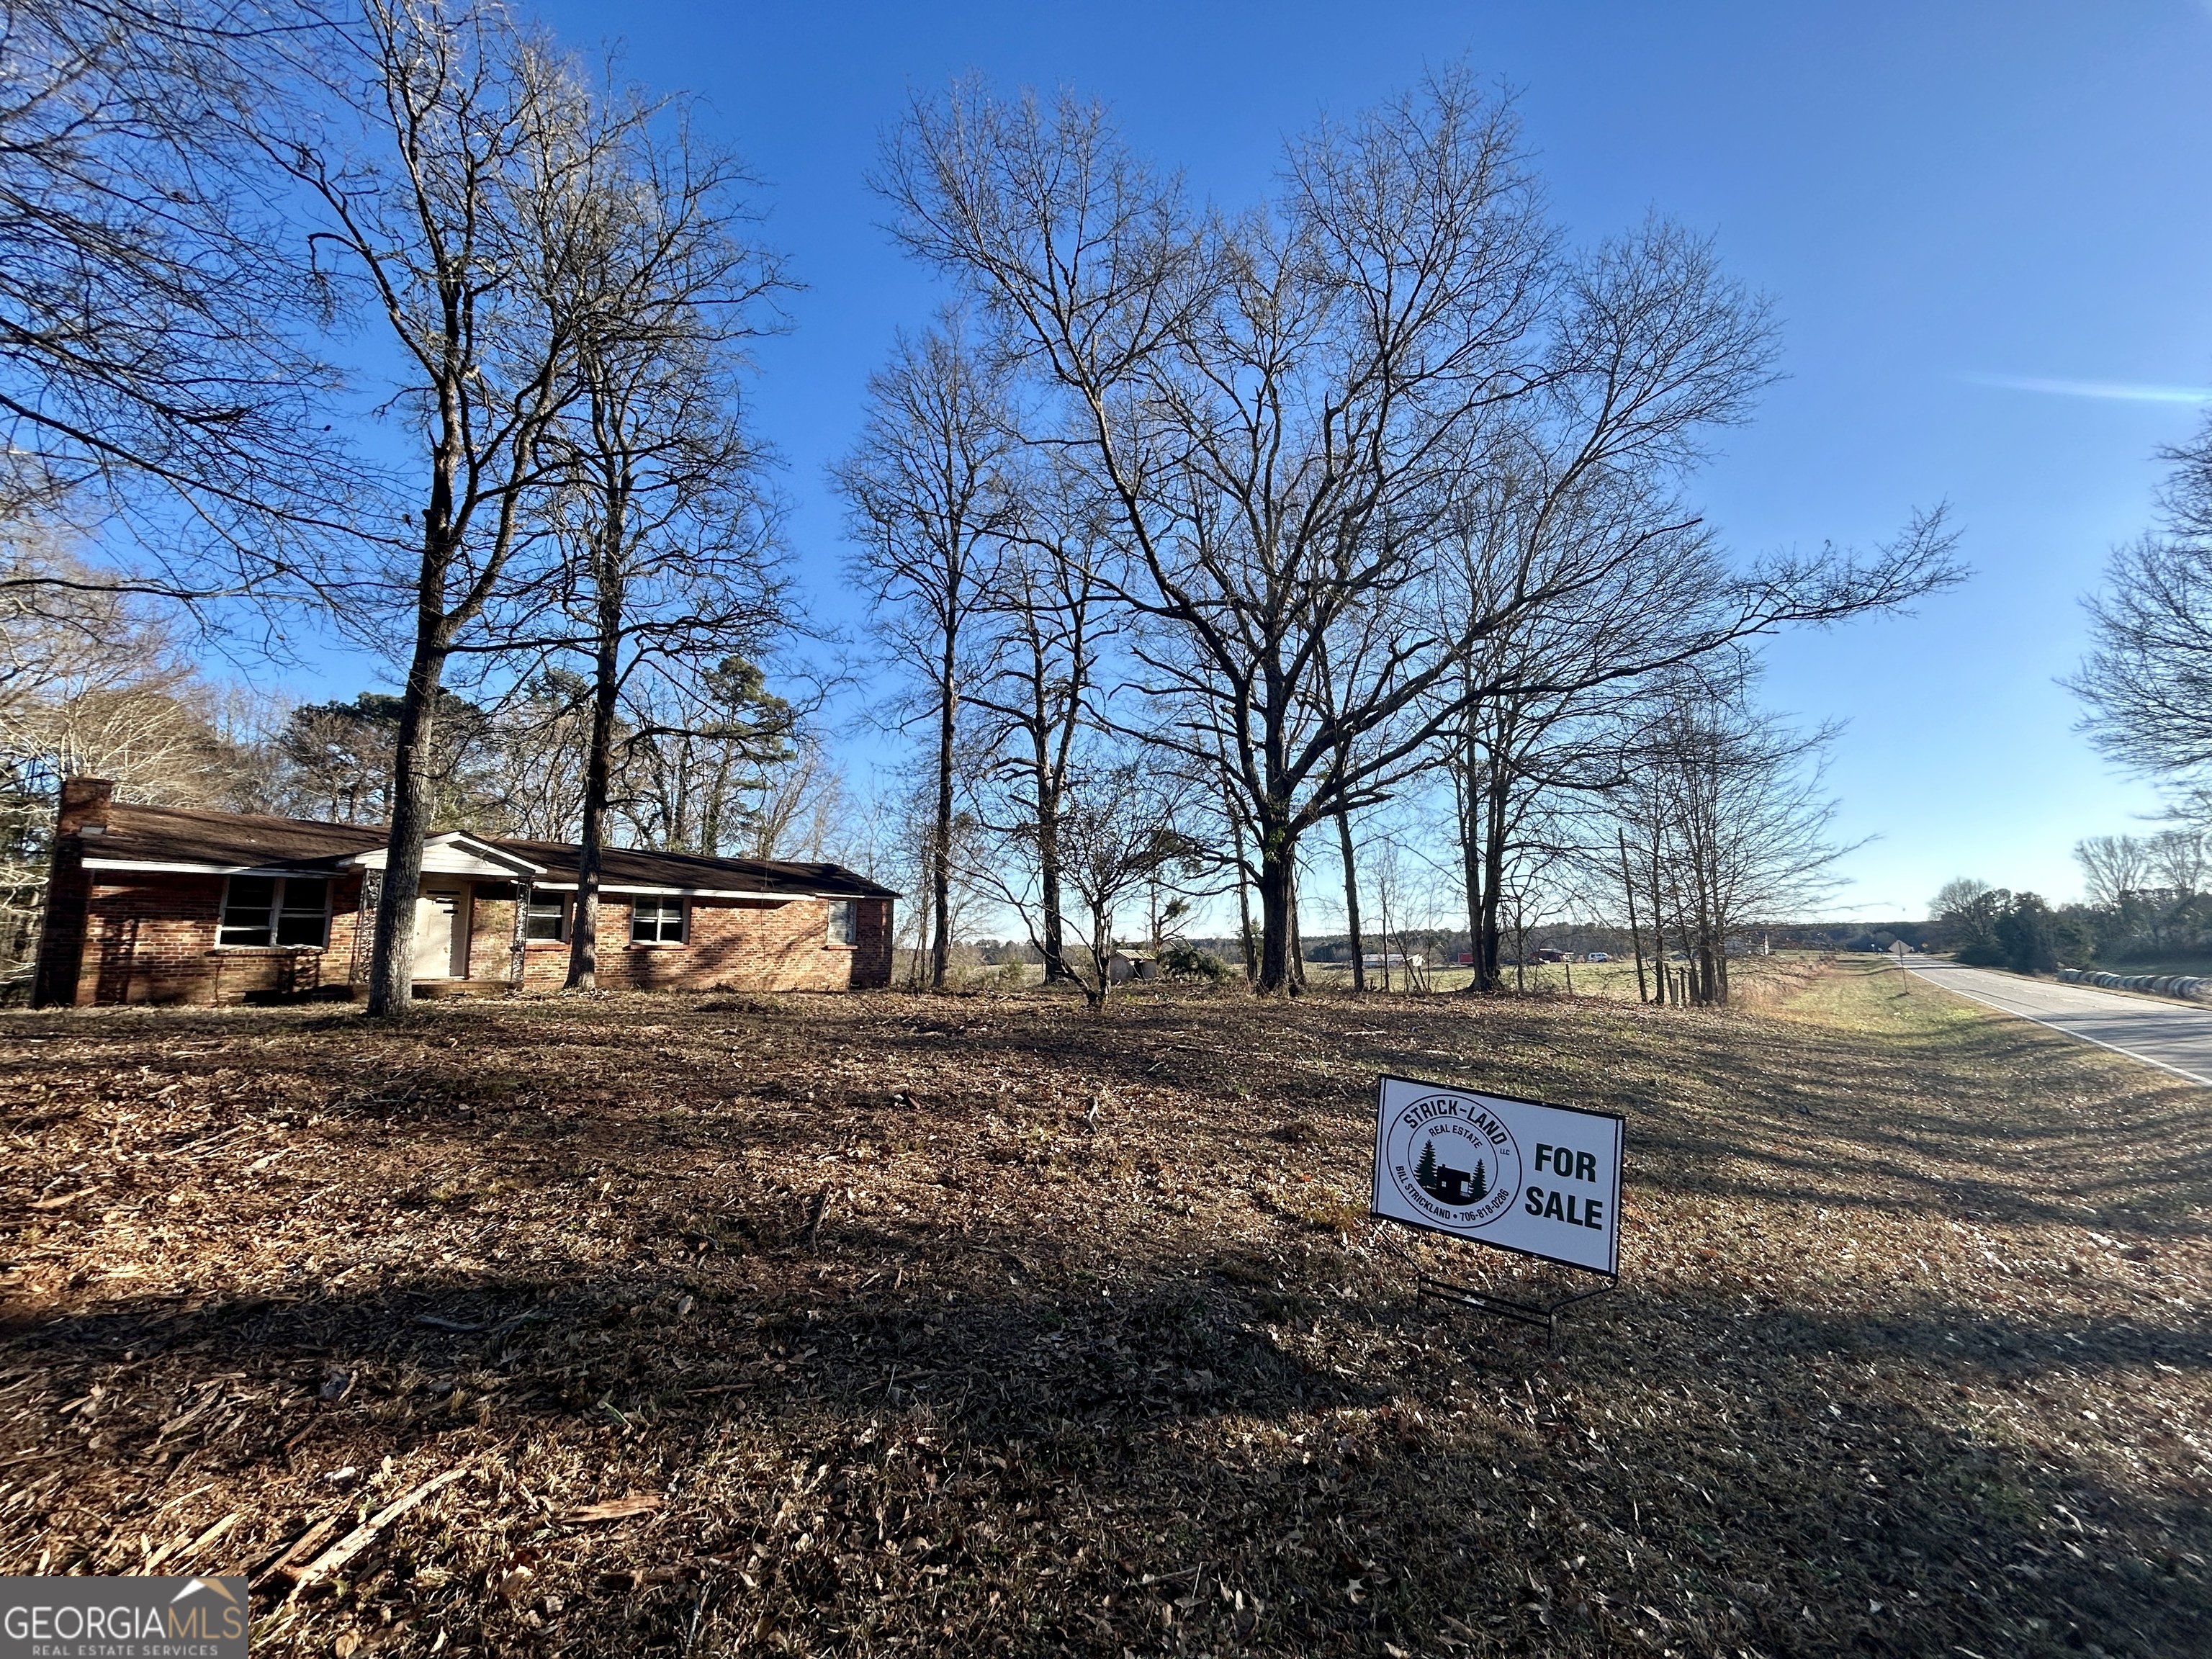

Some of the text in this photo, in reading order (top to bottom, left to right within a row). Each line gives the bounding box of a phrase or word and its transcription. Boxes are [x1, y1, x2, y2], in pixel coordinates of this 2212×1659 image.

[1403, 1099, 1508, 1146] STRICK-LAND
[1428, 1124, 1483, 1149] REAL ESTATE
[1534, 1143, 1596, 1183] FOR
[1395, 1165, 1510, 1222] BILL STRICKLAND 706-818-0286
[1524, 1186, 1603, 1231] SALE
